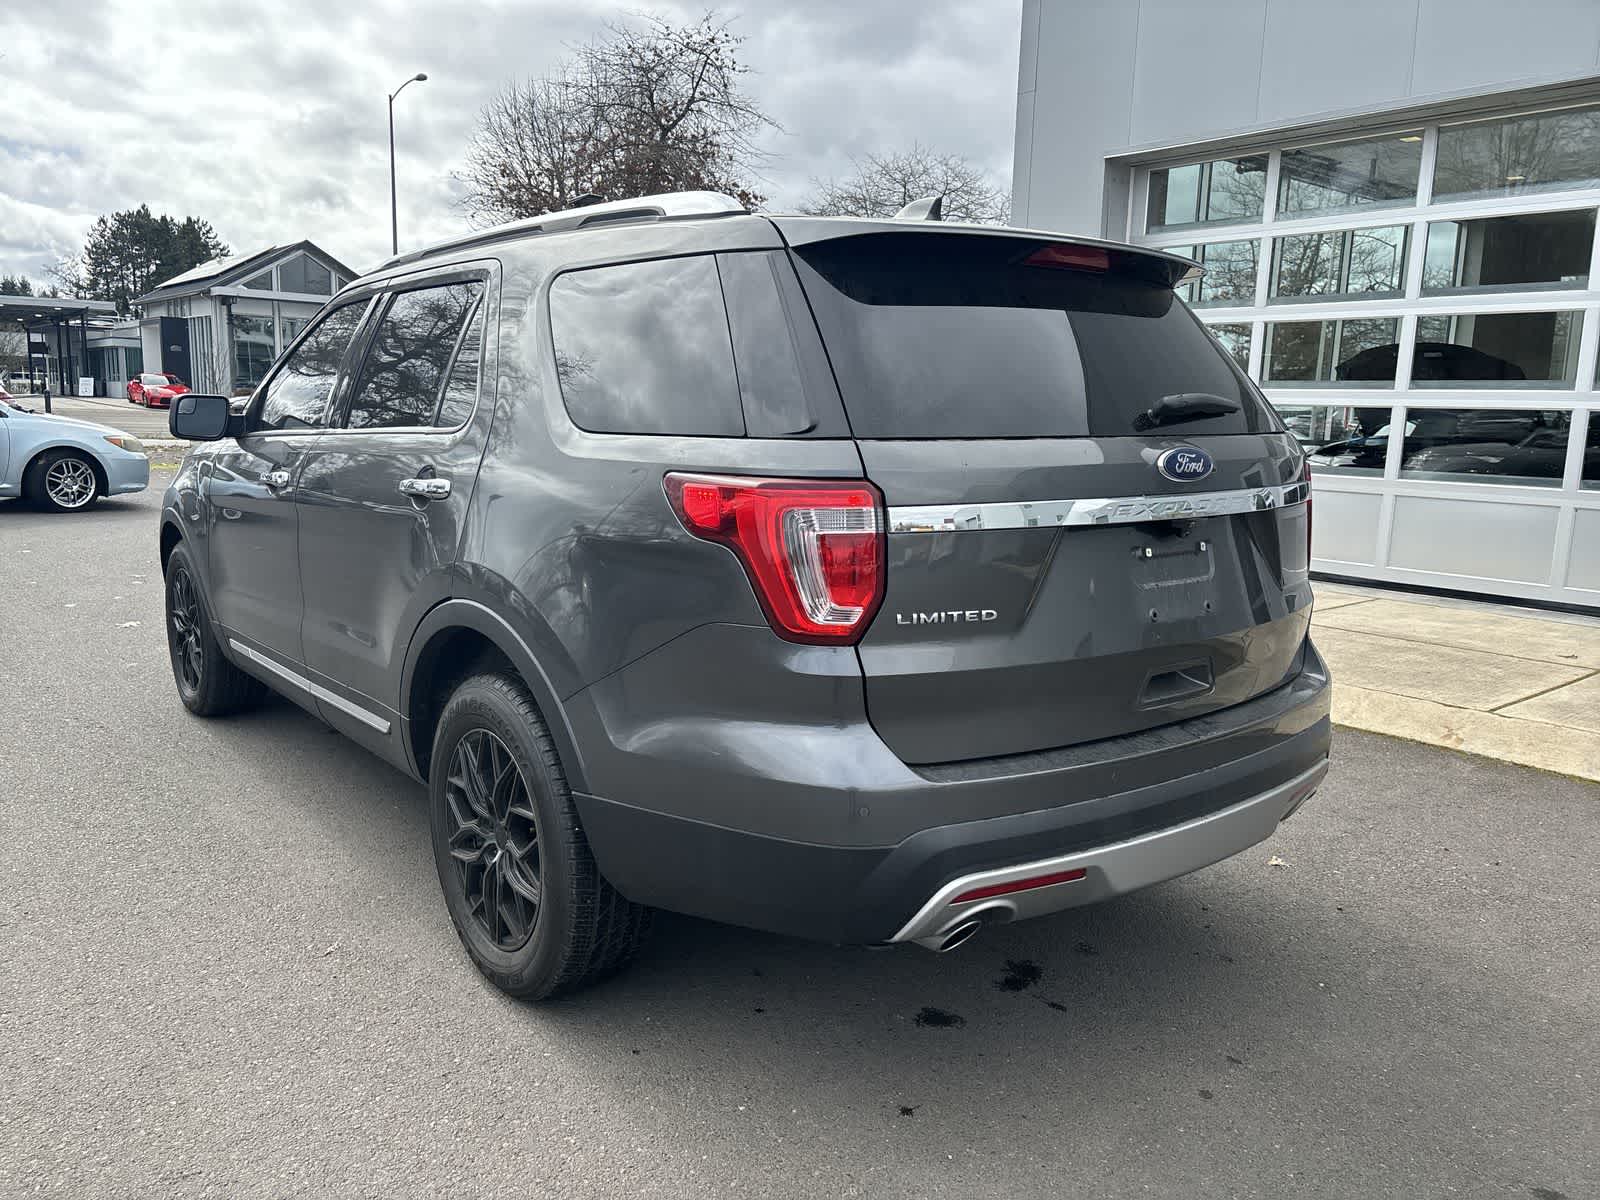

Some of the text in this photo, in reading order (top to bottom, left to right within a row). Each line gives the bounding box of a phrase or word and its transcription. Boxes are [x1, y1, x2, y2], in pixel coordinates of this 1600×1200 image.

[1175, 453, 1205, 473] Ford
[1112, 491, 1256, 518] EXPLO
[896, 609, 998, 625] LIMITED
